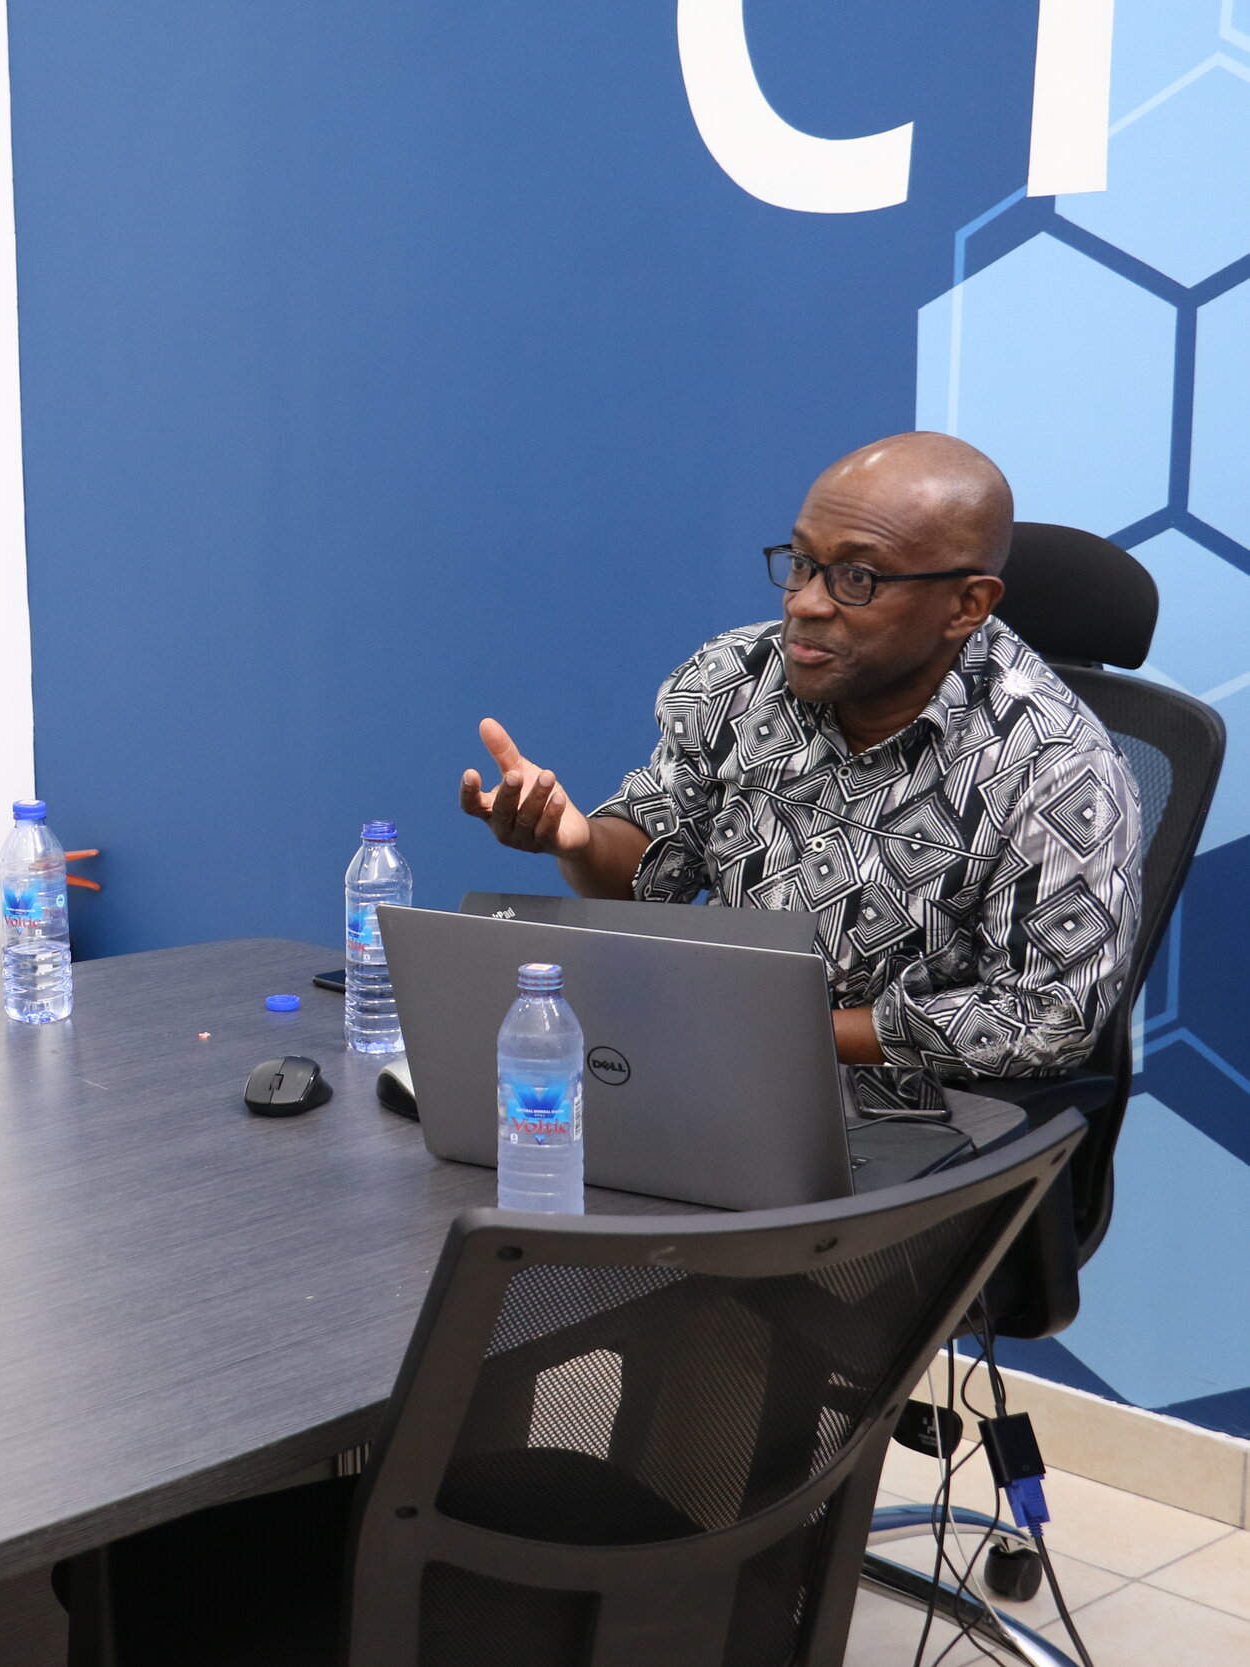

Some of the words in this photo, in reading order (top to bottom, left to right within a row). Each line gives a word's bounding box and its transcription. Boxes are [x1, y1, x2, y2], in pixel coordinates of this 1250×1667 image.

[3, 913, 42, 929] Voltic
[592, 1058, 626, 1073] DELL
[511, 1116, 570, 1134] Voltic
